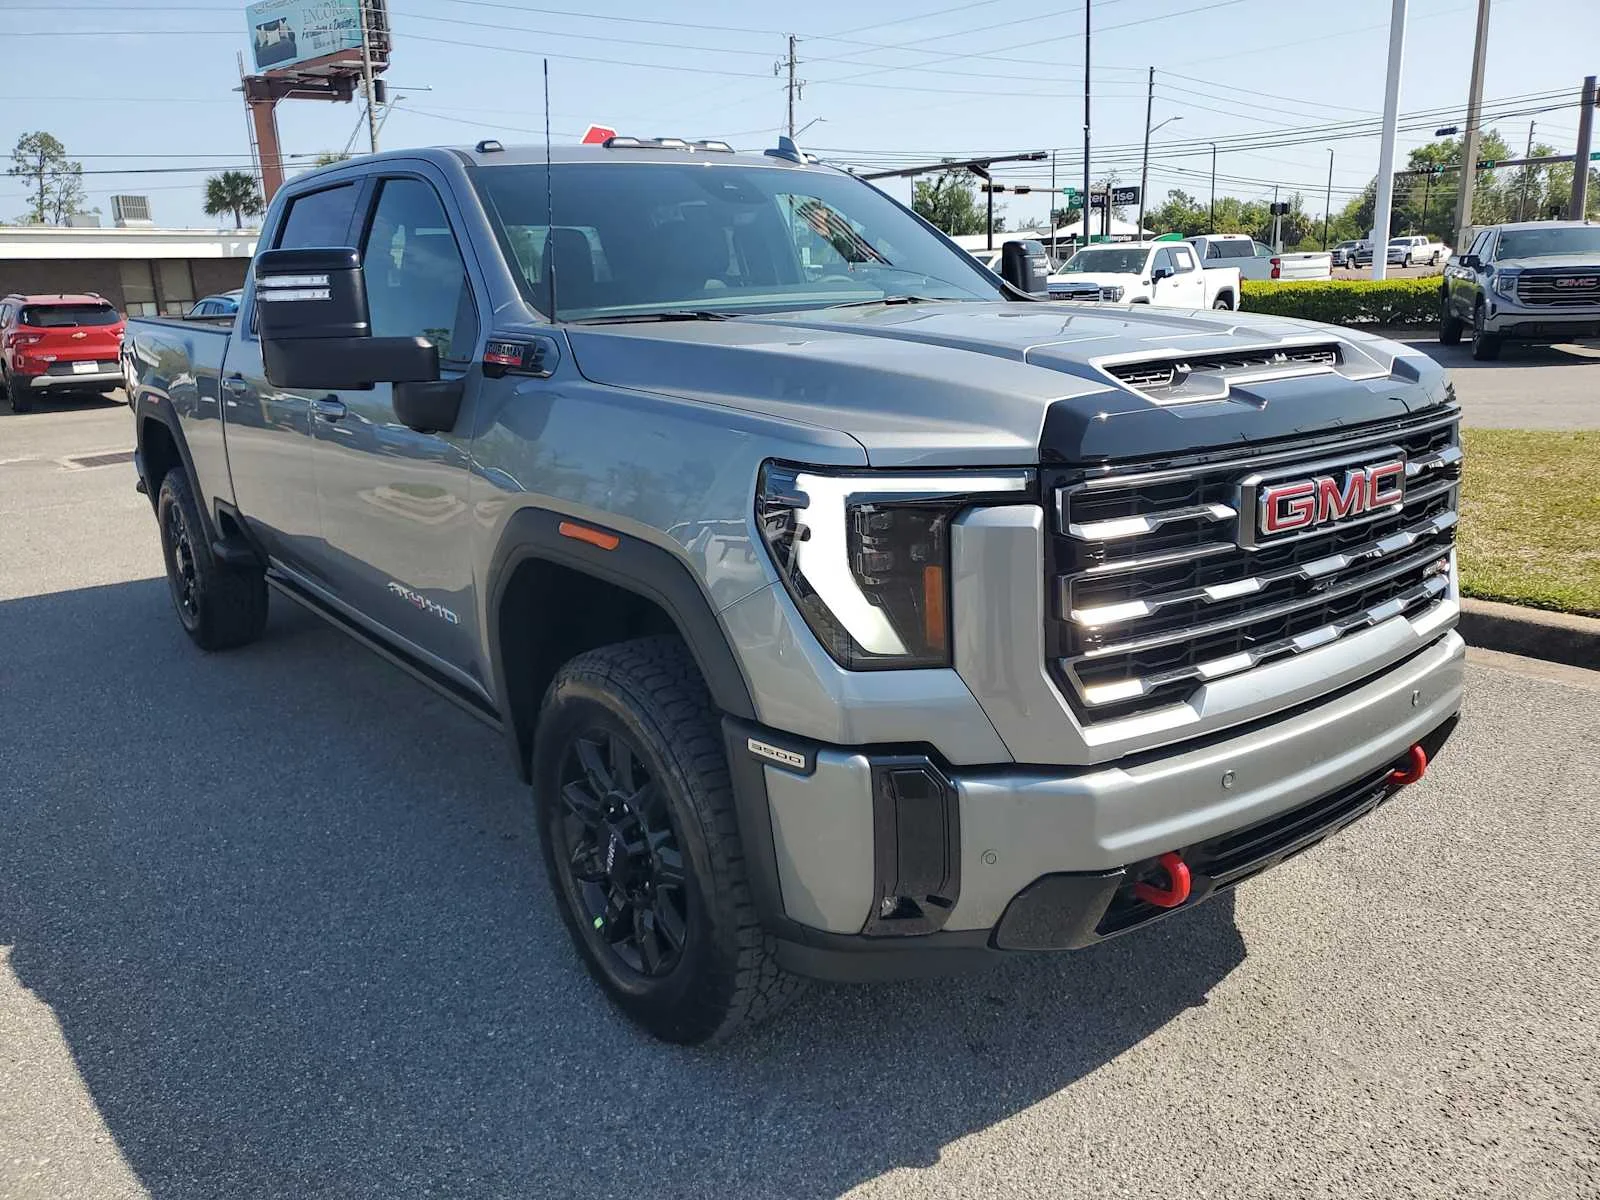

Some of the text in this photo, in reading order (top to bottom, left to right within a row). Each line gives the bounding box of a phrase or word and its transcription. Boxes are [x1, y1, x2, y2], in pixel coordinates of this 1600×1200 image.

[1557, 278, 1597, 287] GMC
[1259, 461, 1403, 535] GMC
[751, 741, 802, 764] 3500
